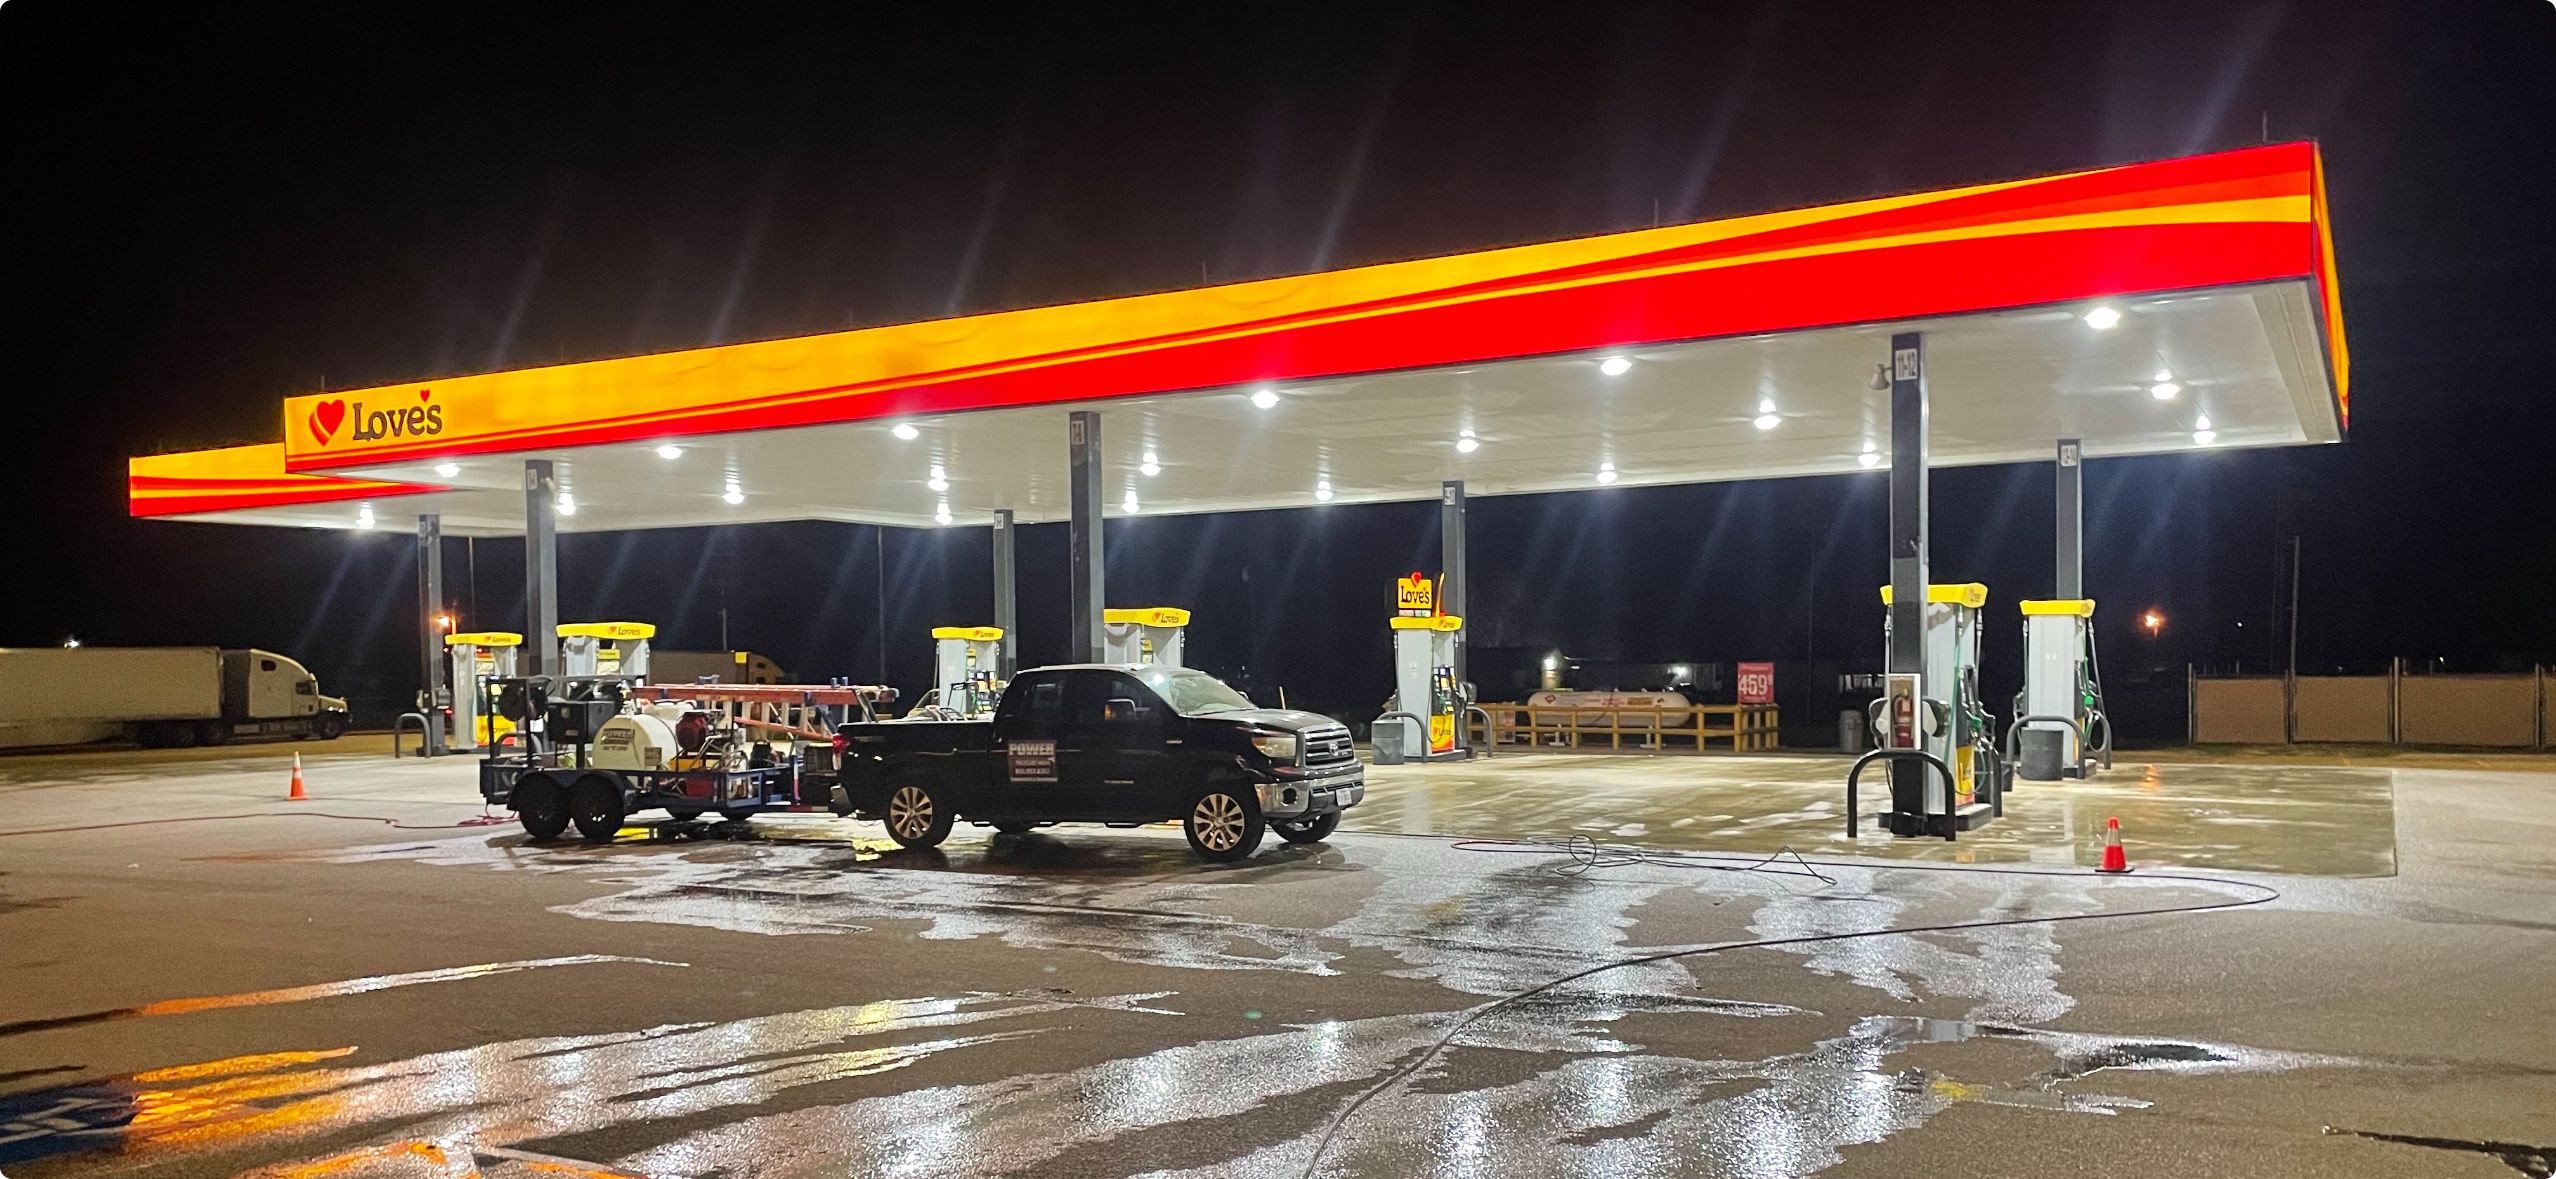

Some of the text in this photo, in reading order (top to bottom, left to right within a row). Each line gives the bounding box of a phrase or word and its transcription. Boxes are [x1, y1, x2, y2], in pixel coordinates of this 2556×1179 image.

[1897, 352, 1917, 378] 11-12
[352, 389, 443, 442] Love's
[1401, 586, 1430, 604] Love's
[1008, 743, 1055, 756] POWER
